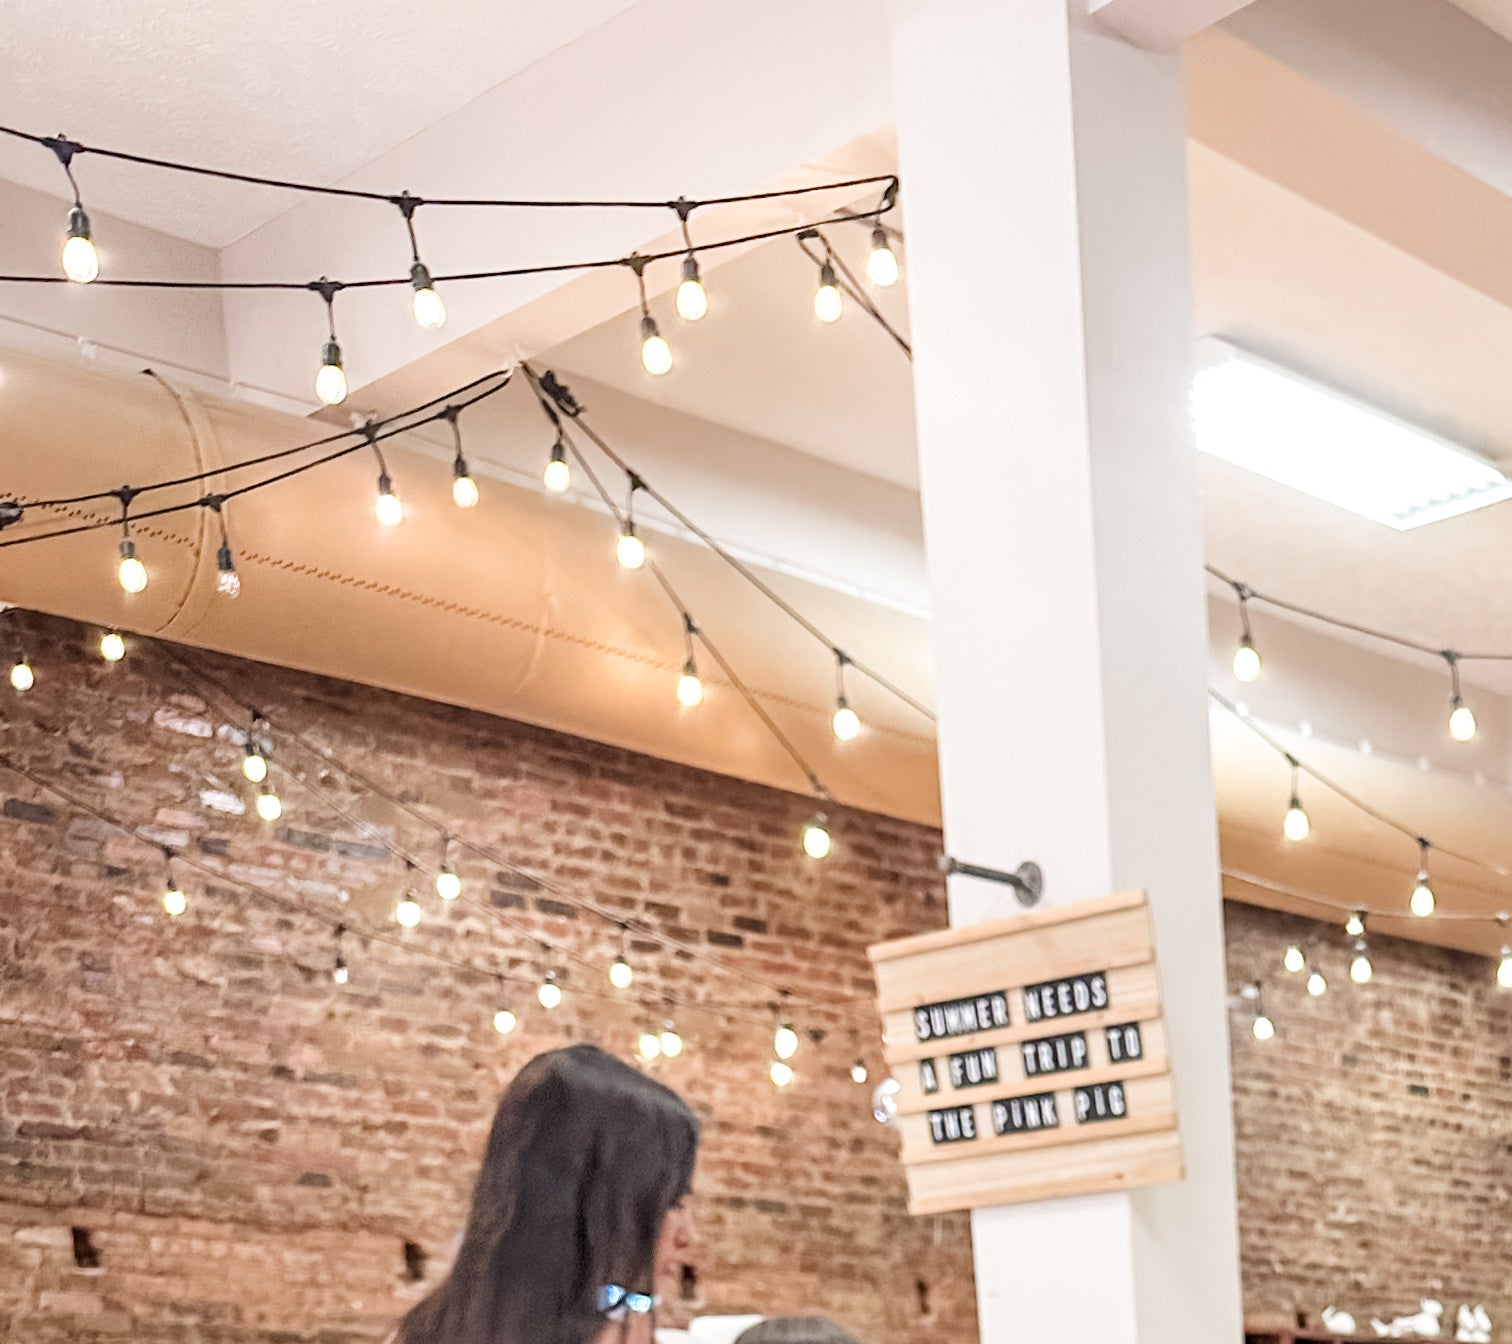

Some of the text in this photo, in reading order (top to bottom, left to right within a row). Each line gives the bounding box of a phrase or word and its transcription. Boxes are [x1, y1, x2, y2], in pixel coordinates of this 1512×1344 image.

[914, 975, 1108, 1040] SUMMER NEEDS
[921, 1026, 1141, 1090] A FUN TRIP TO
[929, 1084, 1126, 1142] THE PINK PIG
